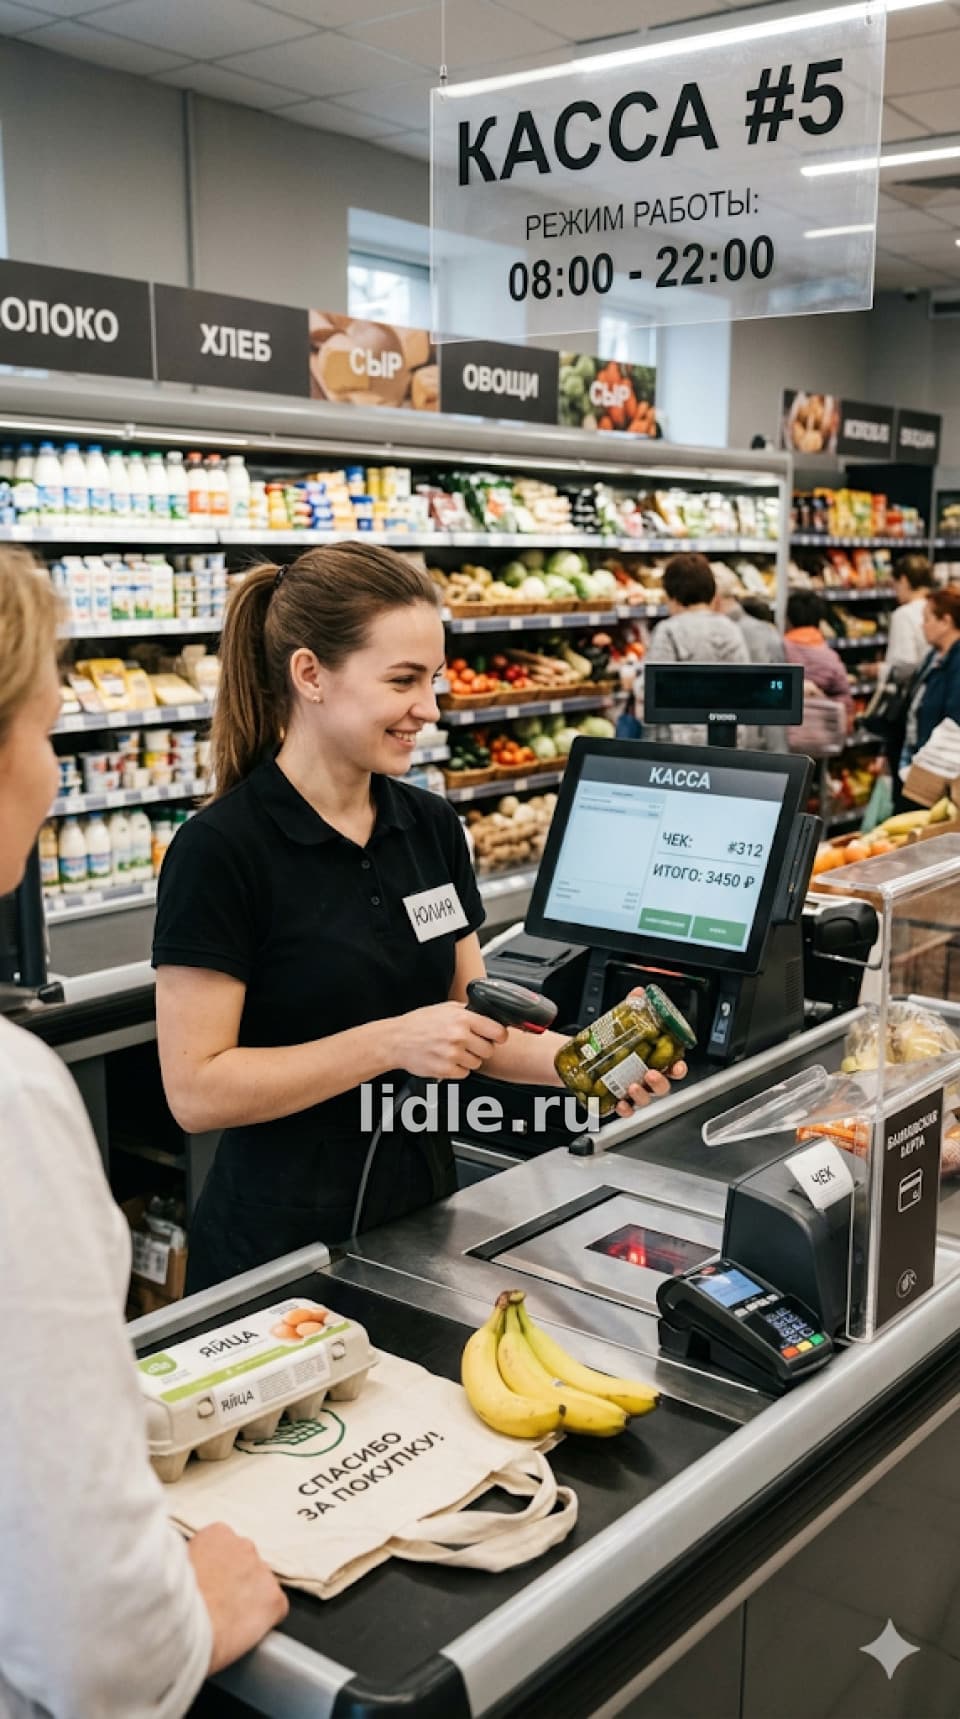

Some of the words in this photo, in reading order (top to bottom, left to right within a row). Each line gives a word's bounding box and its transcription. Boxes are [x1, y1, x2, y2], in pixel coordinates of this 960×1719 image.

[458, 82, 718, 186] КАССА
[744, 58, 845, 145] #5
[526, 203, 624, 241] РЕЖИМ
[634, 188, 760, 228] РАБОТЫ:
[508, 252, 614, 302] 08:00
[655, 235, 774, 288] 22:00
[0, 296, 119, 342] ОЛОКО
[200, 323, 272, 362] ХЛЕБ
[349, 347, 402, 379] СЫР
[462, 363, 540, 401] ОВОЩИ
[590, 380, 631, 408] СЫР
[649, 766, 711, 789] КАССА
[662, 831, 693, 849] ЧЕК:
[727, 841, 763, 857] #312
[652, 863, 704, 882] ИТОГО:
[705, 871, 741, 888] 3450
[412, 897, 456, 926] ЮЛИЯ
[810, 1164, 836, 1185] ЧЕК
[199, 1331, 259, 1358] ЯЙЦА
[221, 1389, 255, 1412] ЯЙЦА
[297, 1500, 336, 1521] ЗА
[331, 1431, 445, 1501] ПОКУПКУ!
[298, 1432, 402, 1496] СПАСИБО
